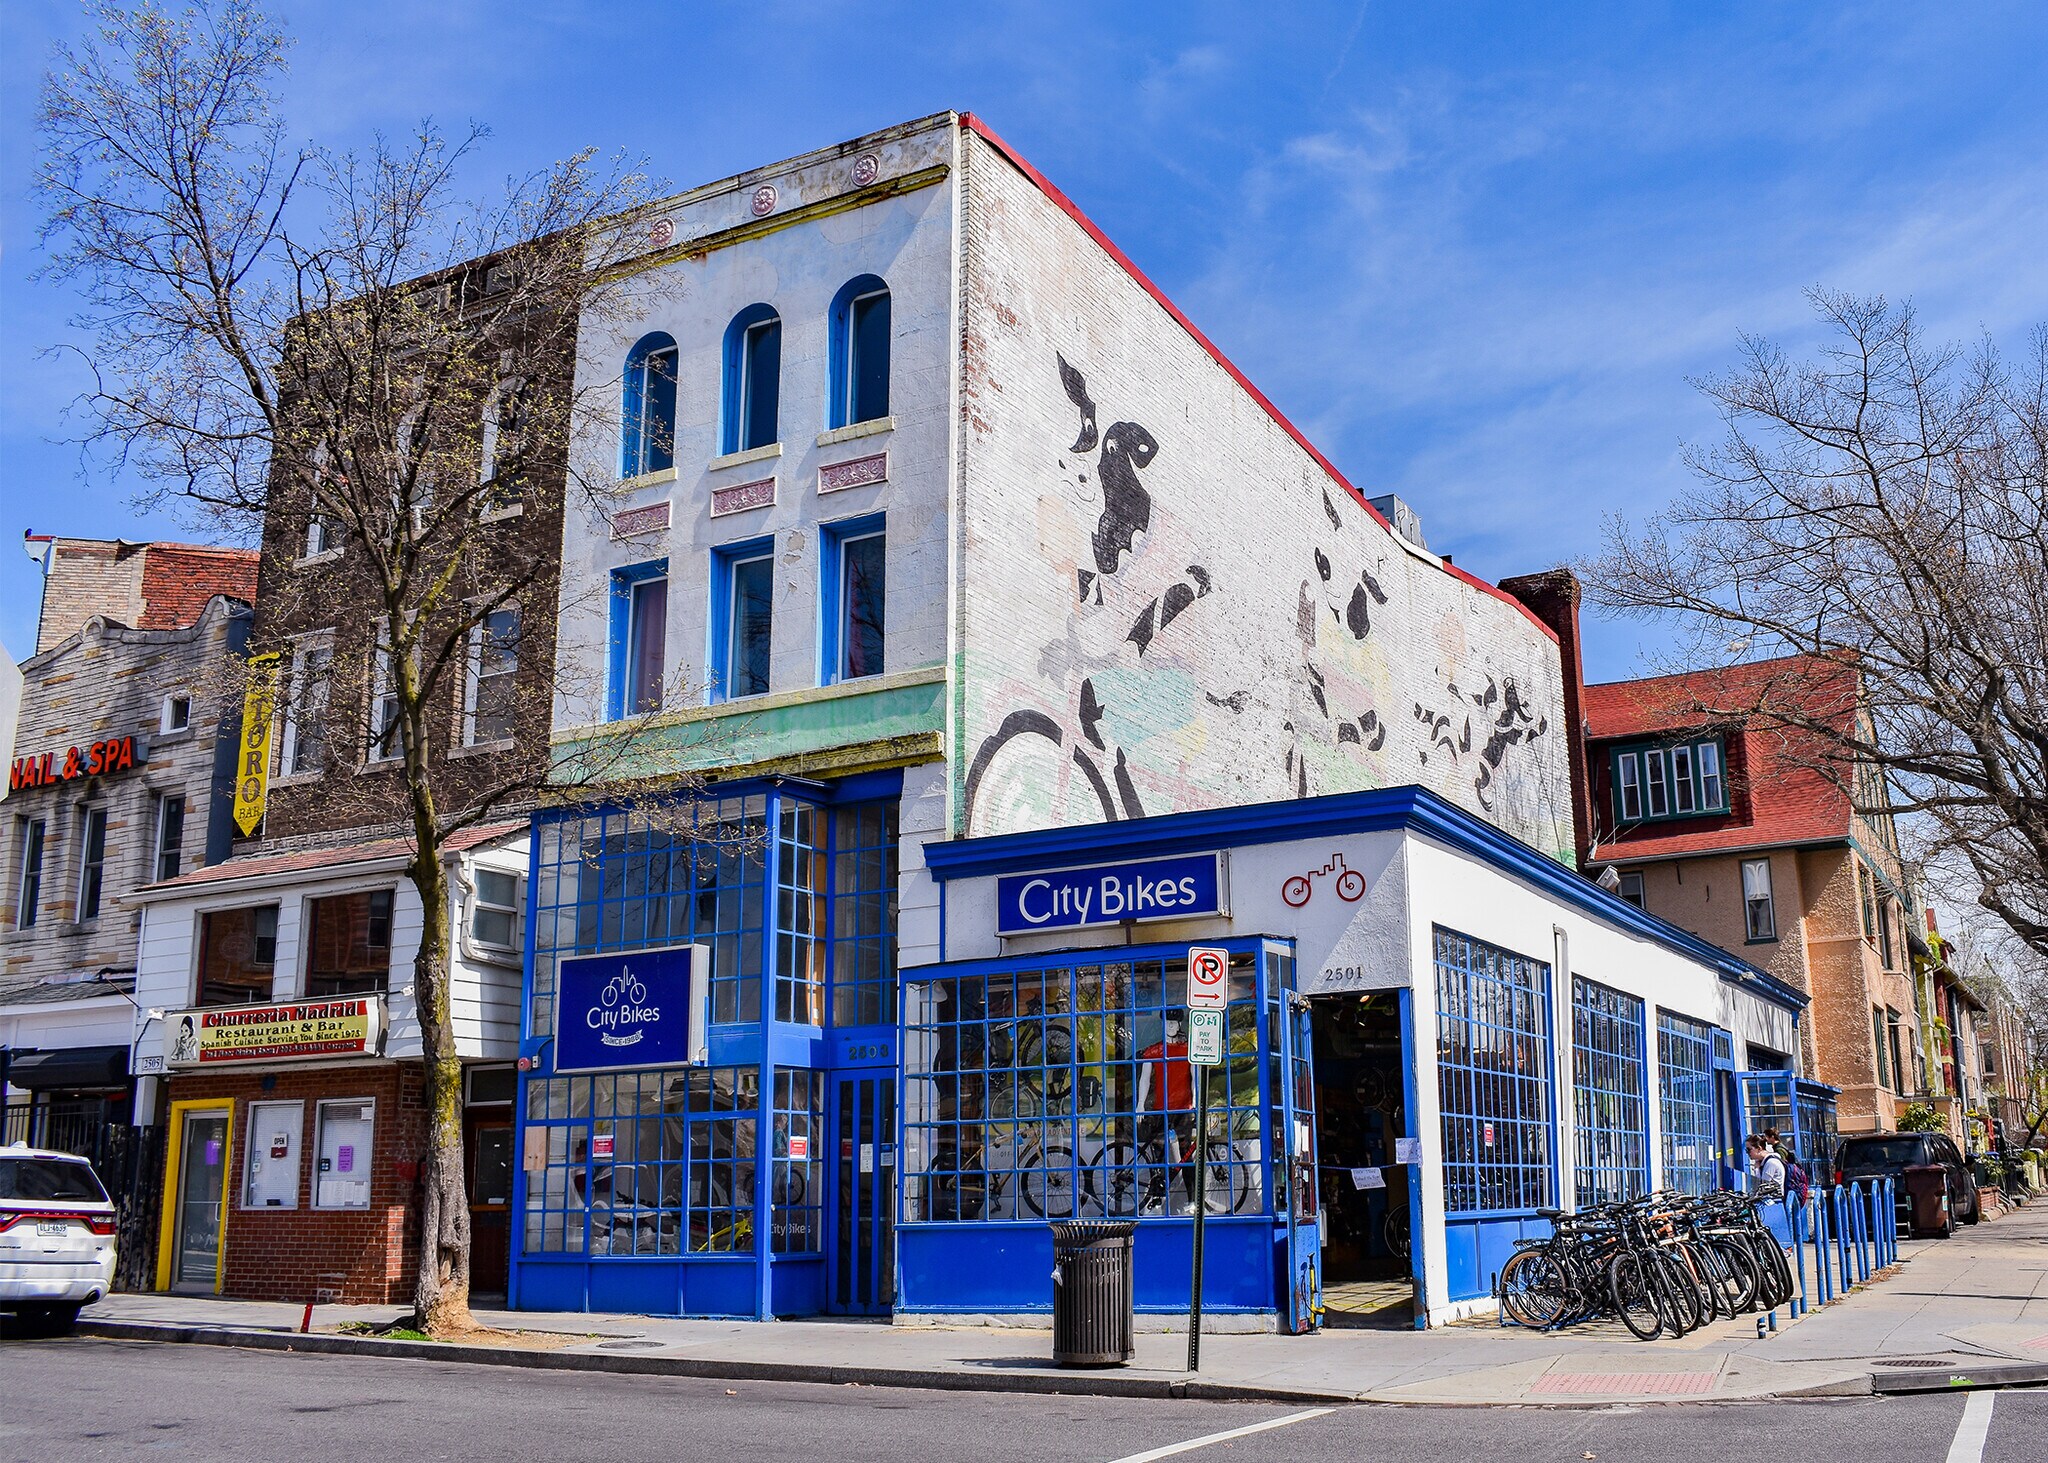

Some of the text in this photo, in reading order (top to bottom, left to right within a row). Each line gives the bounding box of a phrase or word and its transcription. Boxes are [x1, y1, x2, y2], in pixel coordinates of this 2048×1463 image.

[241, 697, 269, 804] TORO
[10, 736, 133, 790] NAIL & SPA
[239, 806, 261, 819] BAR
[1018, 875, 1197, 925] City Bikes
[1325, 966, 1363, 981] 2501
[207, 1001, 359, 1028] Churreria Madrid
[586, 1005, 660, 1030] City Bikes
[215, 1021, 345, 1039] Restaurant & Bar
[201, 1039, 232, 1049] Spanish
[234, 1037, 264, 1047] Cuisine
[267, 1034, 299, 1044] Serving
[299, 1032, 314, 1041] You
[316, 1031, 339, 1040] Since
[603, 1034, 623, 1046] SINCE
[848, 1044, 889, 1060] 2503
[273, 1137, 285, 1145] OPEN
